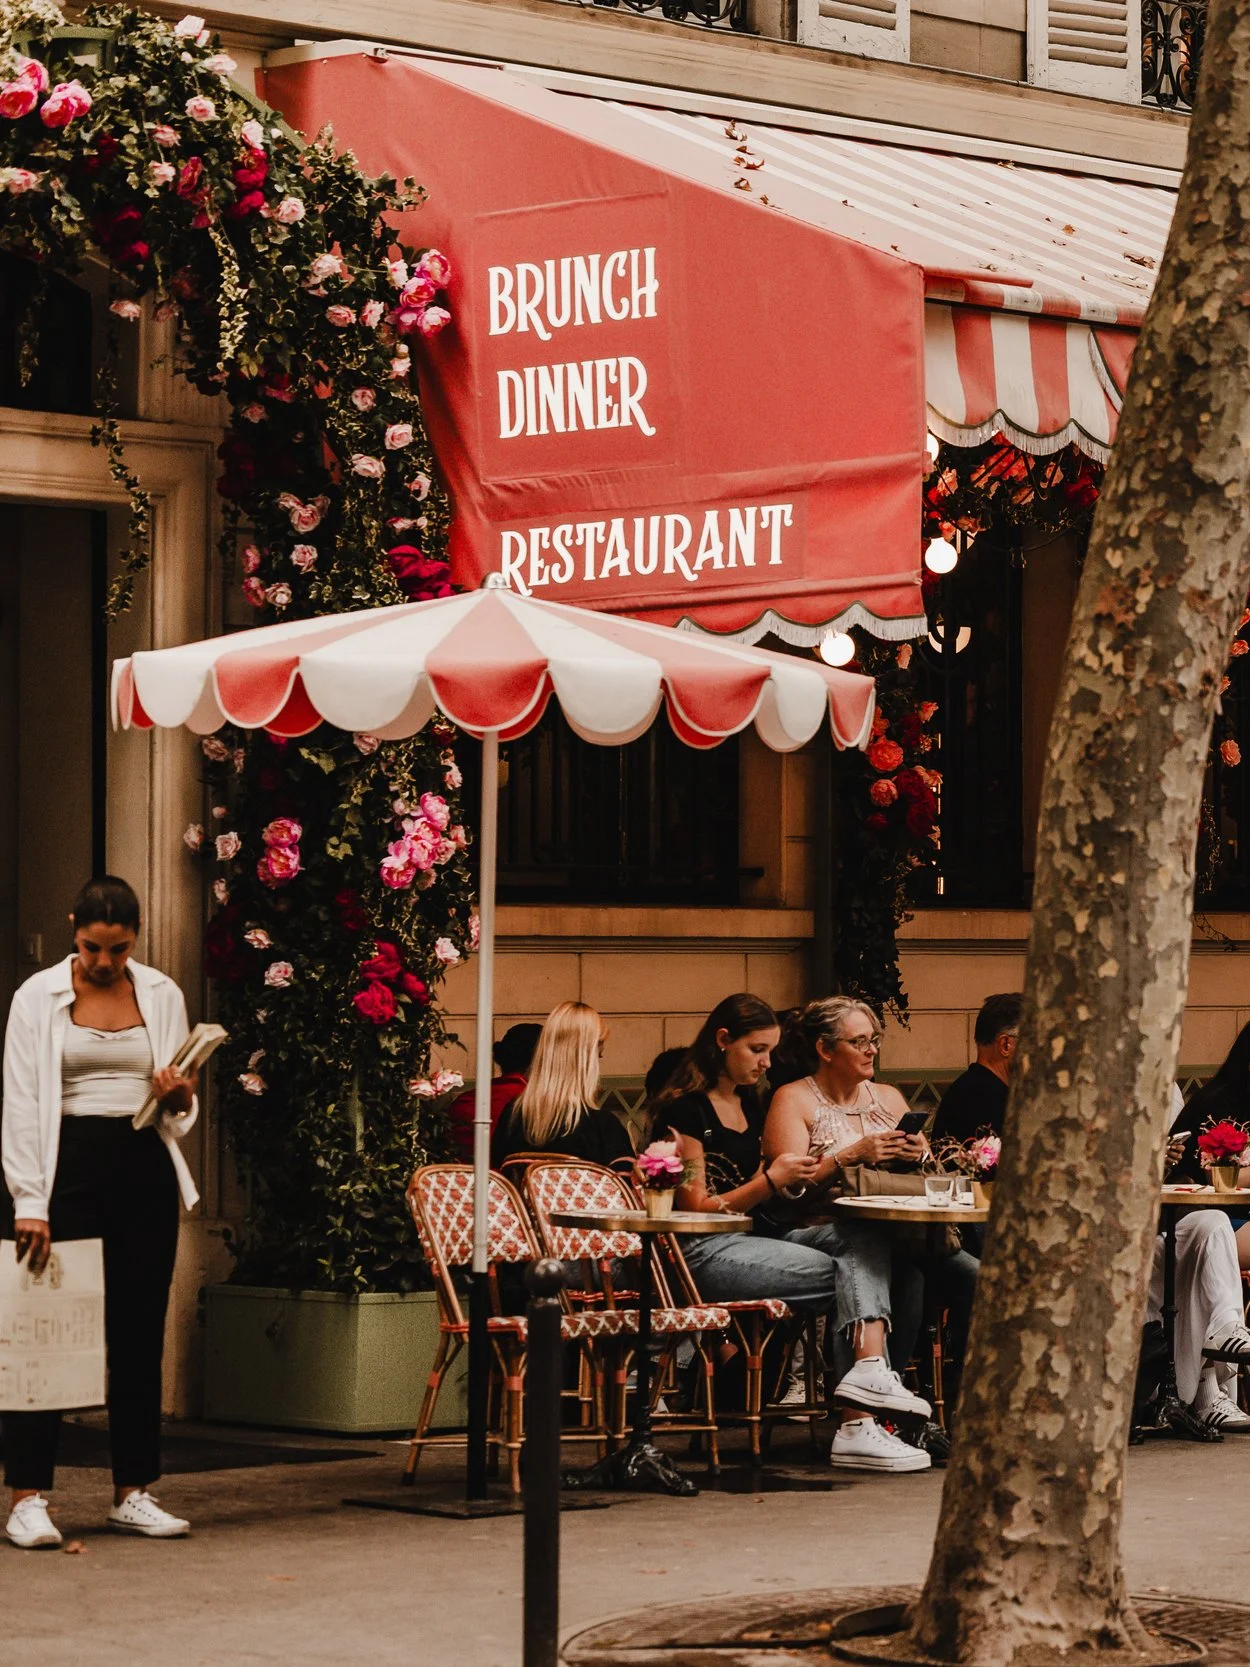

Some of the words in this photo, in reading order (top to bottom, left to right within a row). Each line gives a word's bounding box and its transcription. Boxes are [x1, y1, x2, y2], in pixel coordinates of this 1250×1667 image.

[488, 247, 659, 341] BRUNCH
[497, 356, 656, 438] DINNER
[500, 504, 793, 597] RESTAURANT
